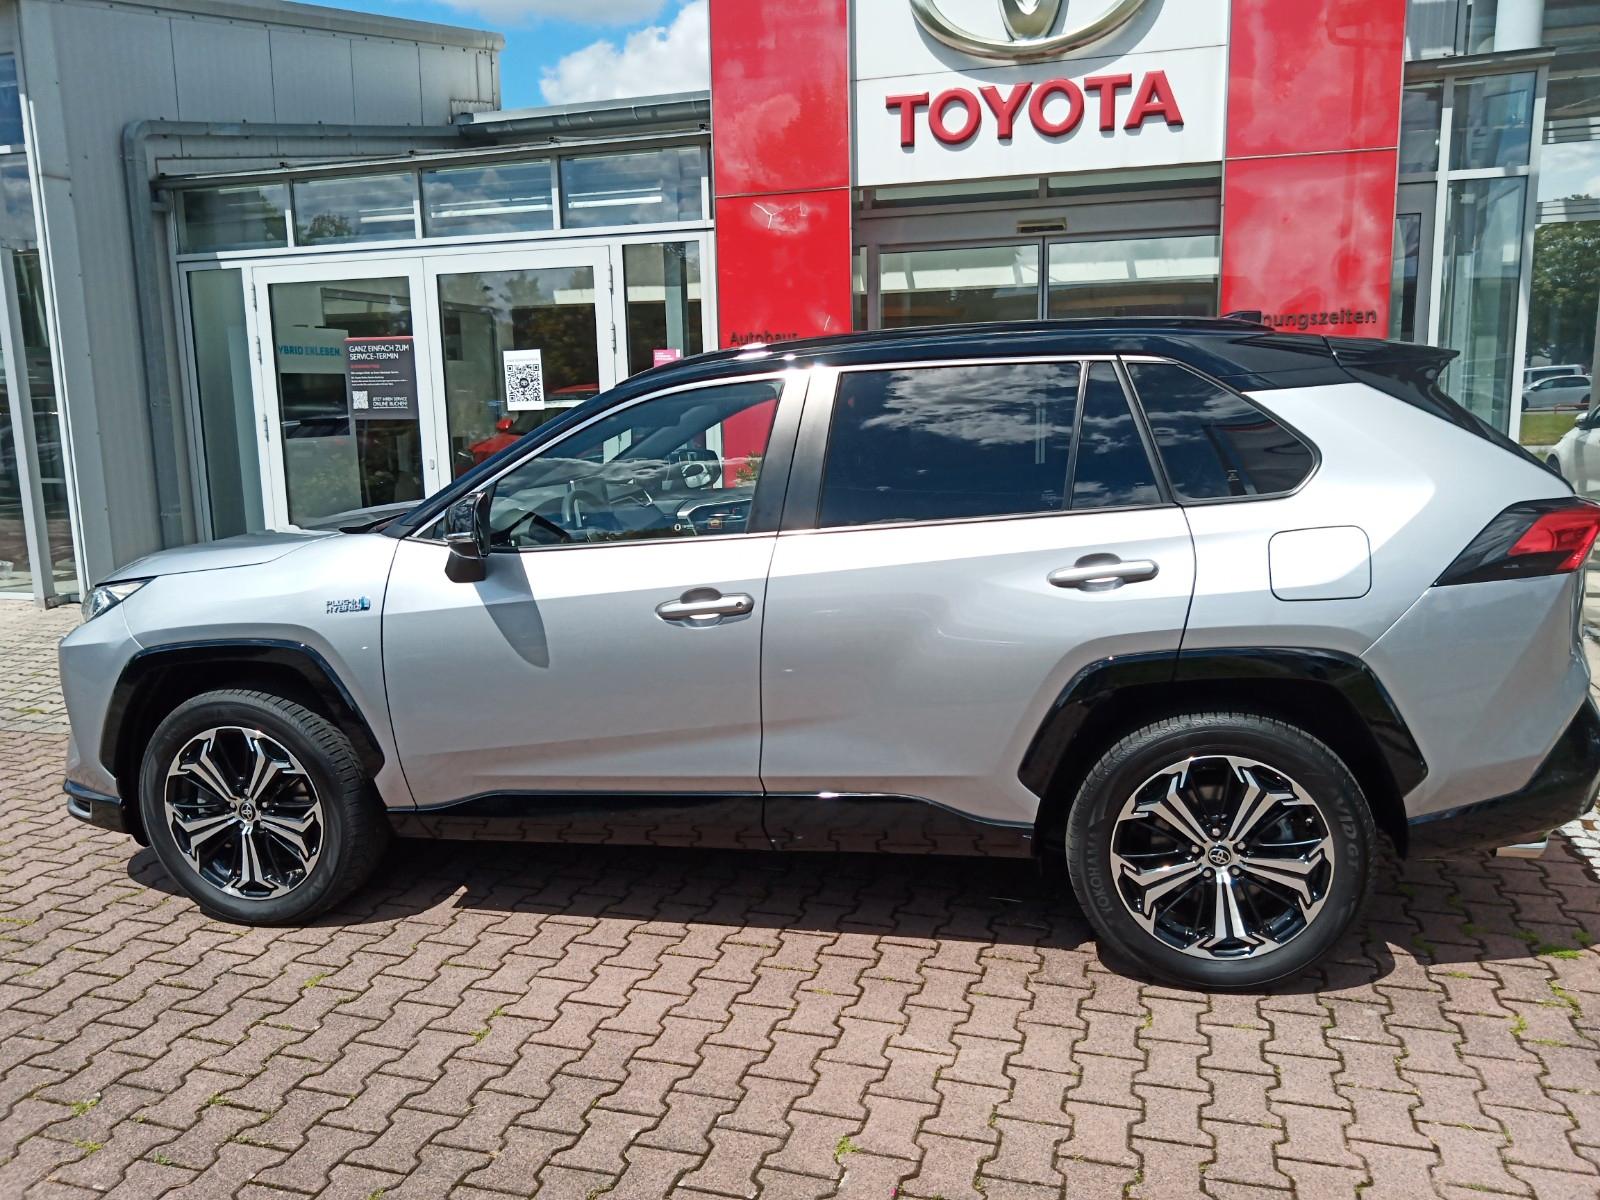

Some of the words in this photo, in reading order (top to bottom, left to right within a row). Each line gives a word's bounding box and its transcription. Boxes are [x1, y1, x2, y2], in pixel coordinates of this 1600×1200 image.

[885, 69, 1184, 148] TOYOTA
[1262, 307, 1377, 330] nungszeiten
[278, 345, 303, 355] YBRID
[349, 345, 367, 353] GANZ
[368, 344, 394, 352] EINFACH
[349, 352, 399, 361] SERVICE-TERMIN
[1087, 832, 1113, 913] YOKOHAMA
